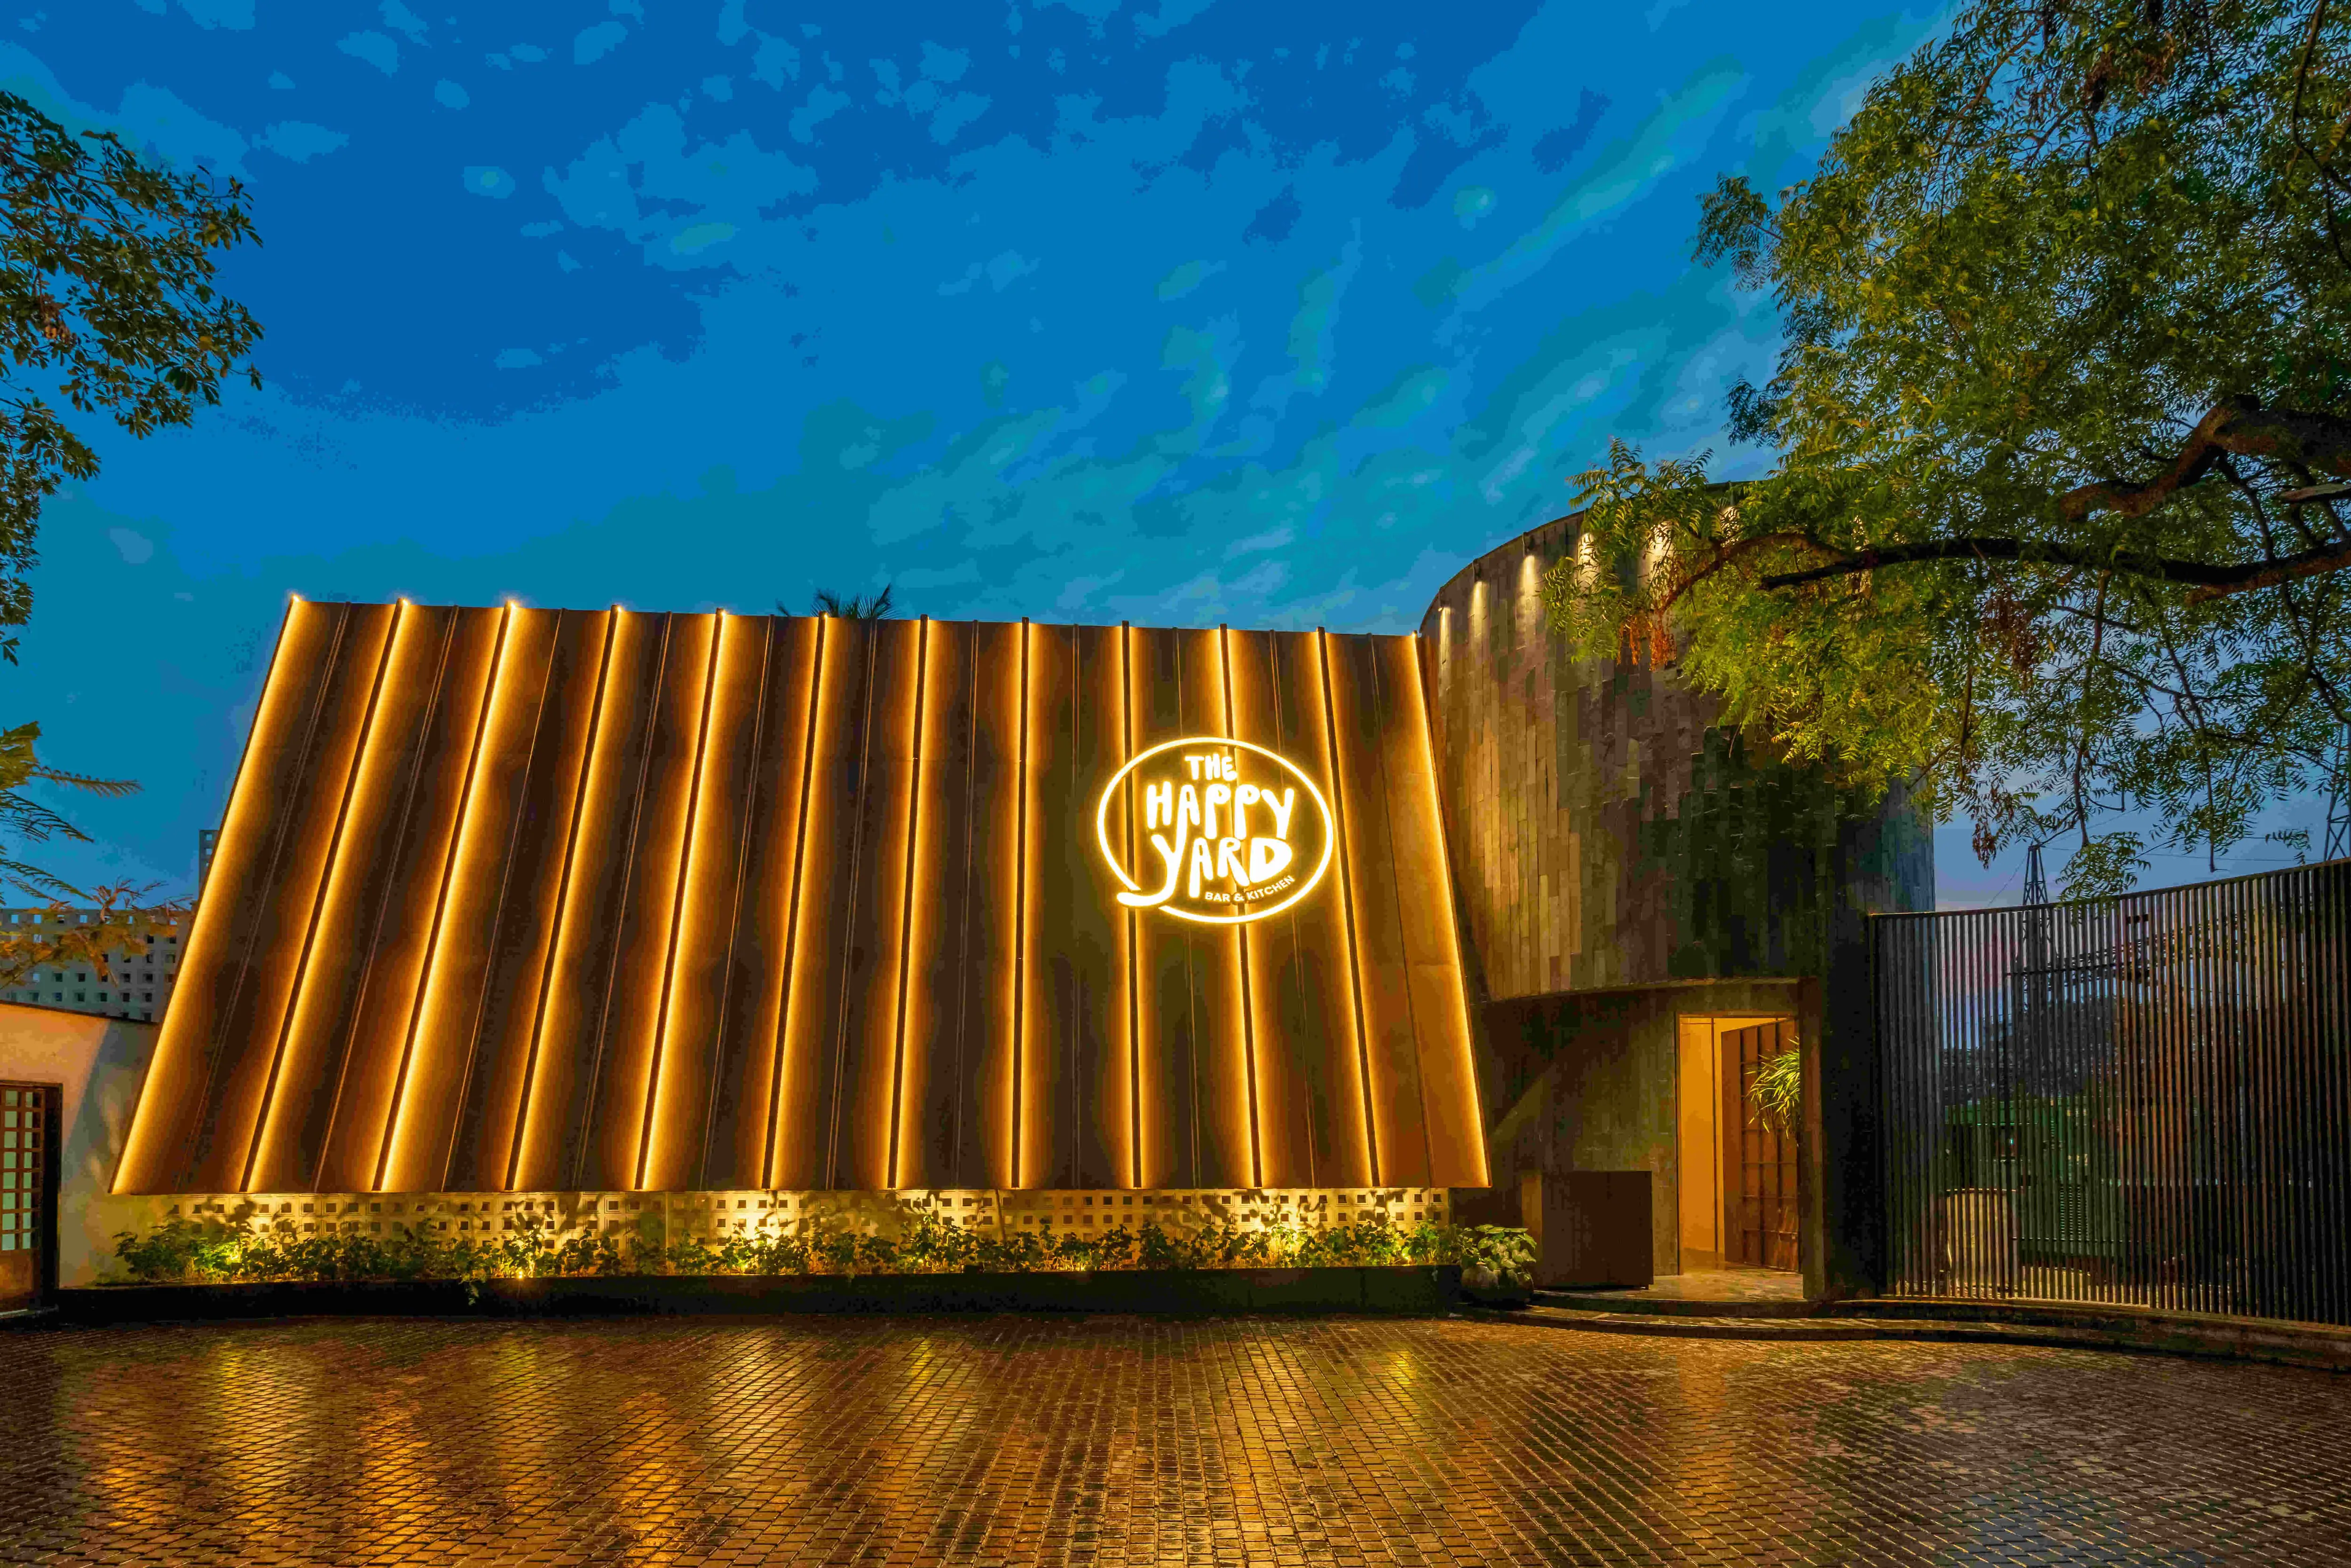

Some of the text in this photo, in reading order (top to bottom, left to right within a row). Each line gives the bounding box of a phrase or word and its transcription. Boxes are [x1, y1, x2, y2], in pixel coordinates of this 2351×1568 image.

[1185, 753, 1237, 781] THE
[1146, 781, 1294, 840] HAPPY
[1117, 835, 1293, 906] YARD
[1205, 875, 1295, 902] BAR & KITCHEN
